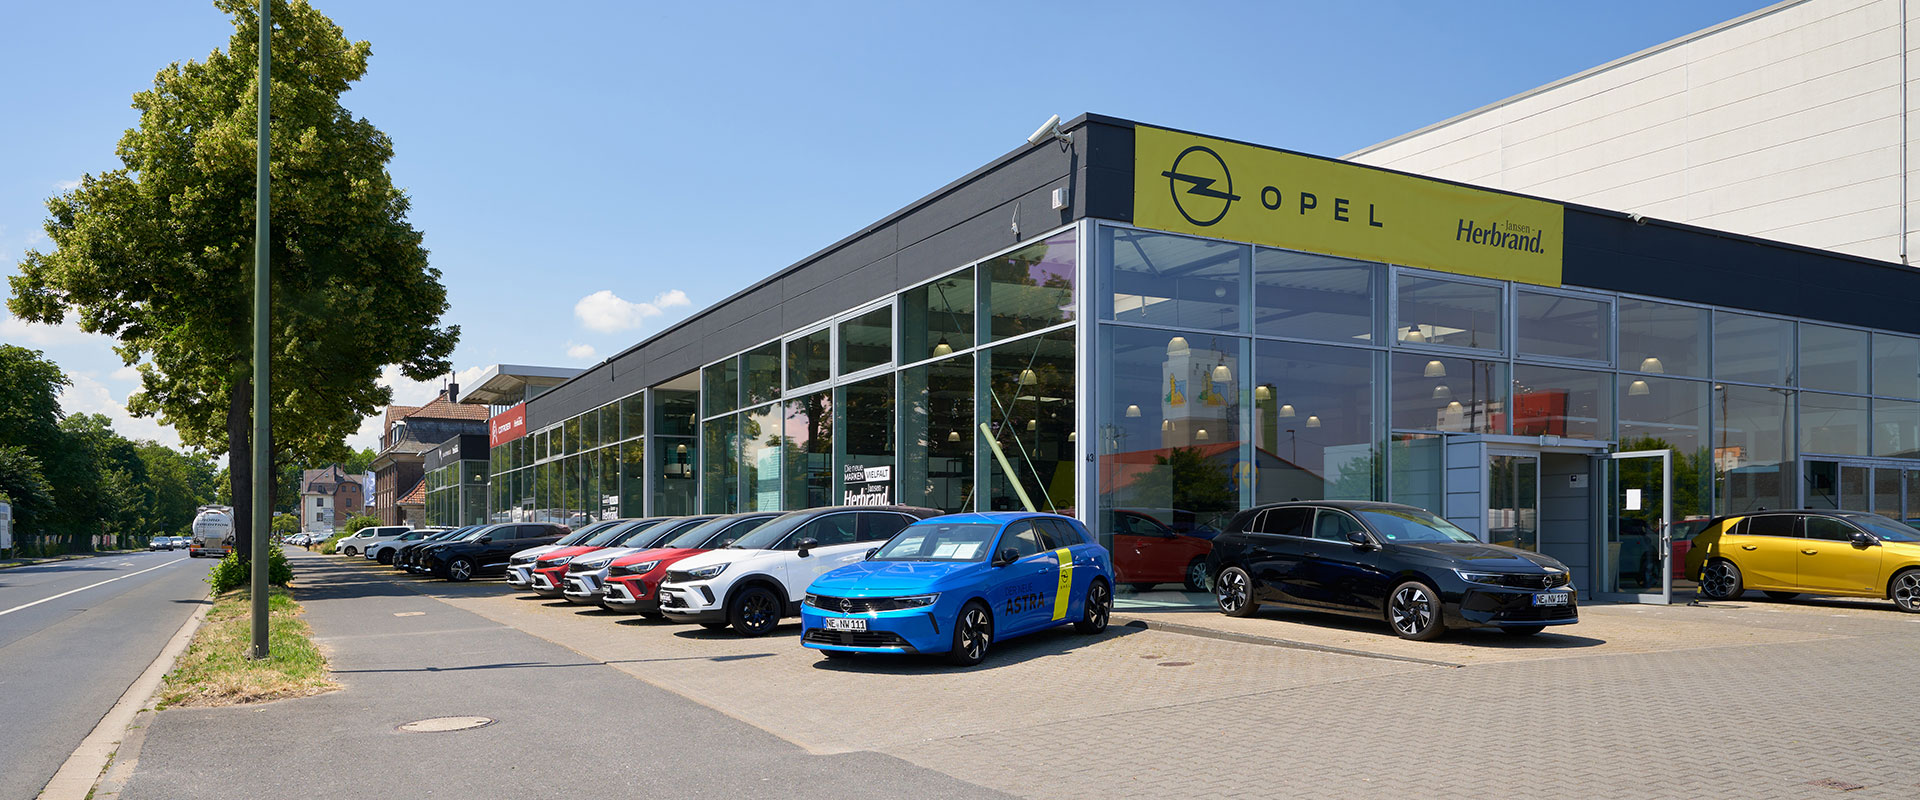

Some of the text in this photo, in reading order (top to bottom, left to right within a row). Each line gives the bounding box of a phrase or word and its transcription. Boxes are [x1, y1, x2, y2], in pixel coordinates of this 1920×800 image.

[1261, 185, 1383, 228] OPEL
[1505, 220, 1531, 234] Jansen
[1456, 219, 1545, 254] Herbrand.
[1086, 453, 1095, 463] 43
[844, 464, 864, 473] Die neue
[844, 469, 889, 481] MARKEN VIELFALT
[867, 483, 882, 493] Jansen
[843, 486, 890, 506] Herbrand.
[1005, 591, 1045, 616] ASTRA
[1537, 595, 1545, 604] NE
[1557, 594, 1568, 603] 112
[826, 619, 836, 628] NE
[851, 620, 865, 629] 111
